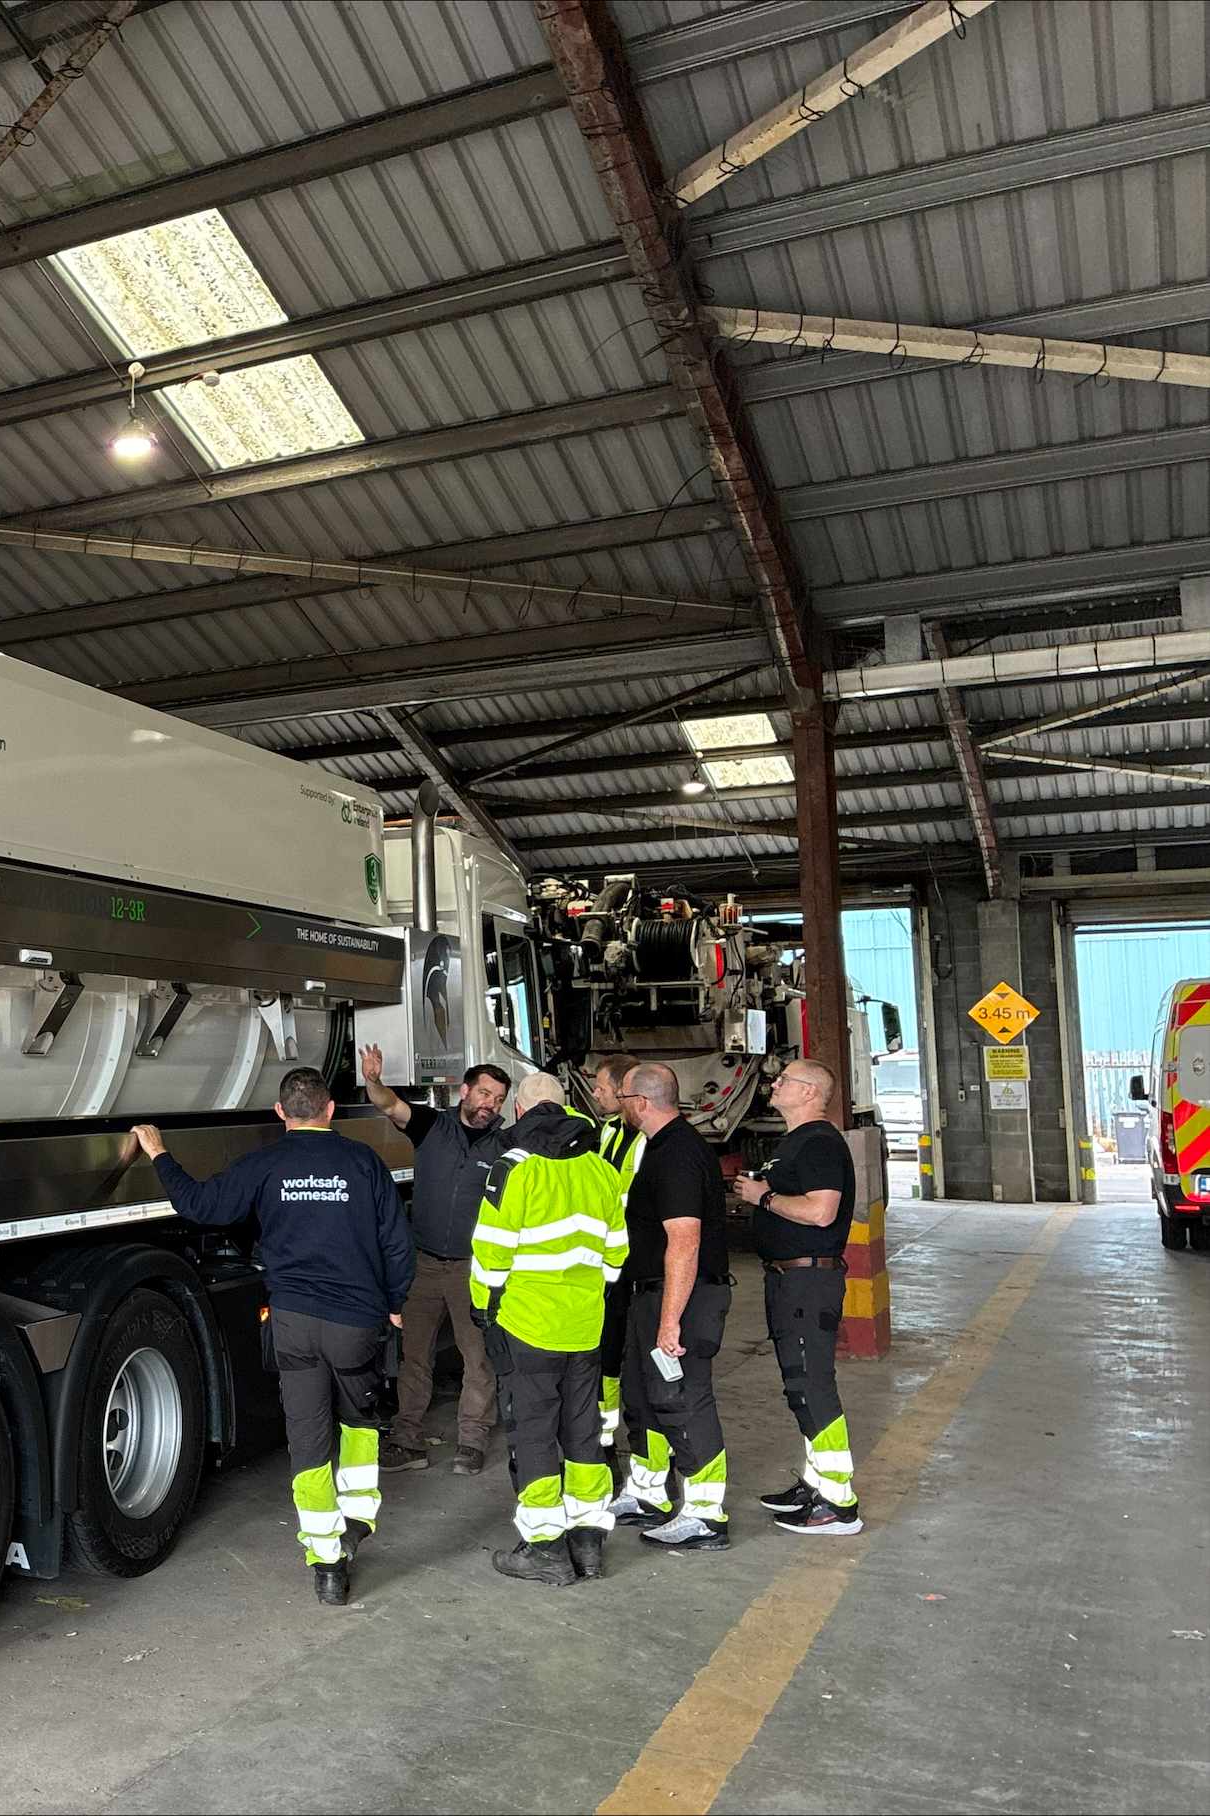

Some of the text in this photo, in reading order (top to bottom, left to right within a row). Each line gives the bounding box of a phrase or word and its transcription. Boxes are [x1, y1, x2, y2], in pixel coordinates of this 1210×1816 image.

[300, 784, 328, 802] Supported
[110, 896, 146, 922] 12-3R
[296, 928, 380, 952] THE HOME OF SUSTAINABILITY
[978, 1007, 1031, 1020] 3.45 m
[281, 1174, 348, 1189] worksafe
[280, 1188, 350, 1202] homesafe
